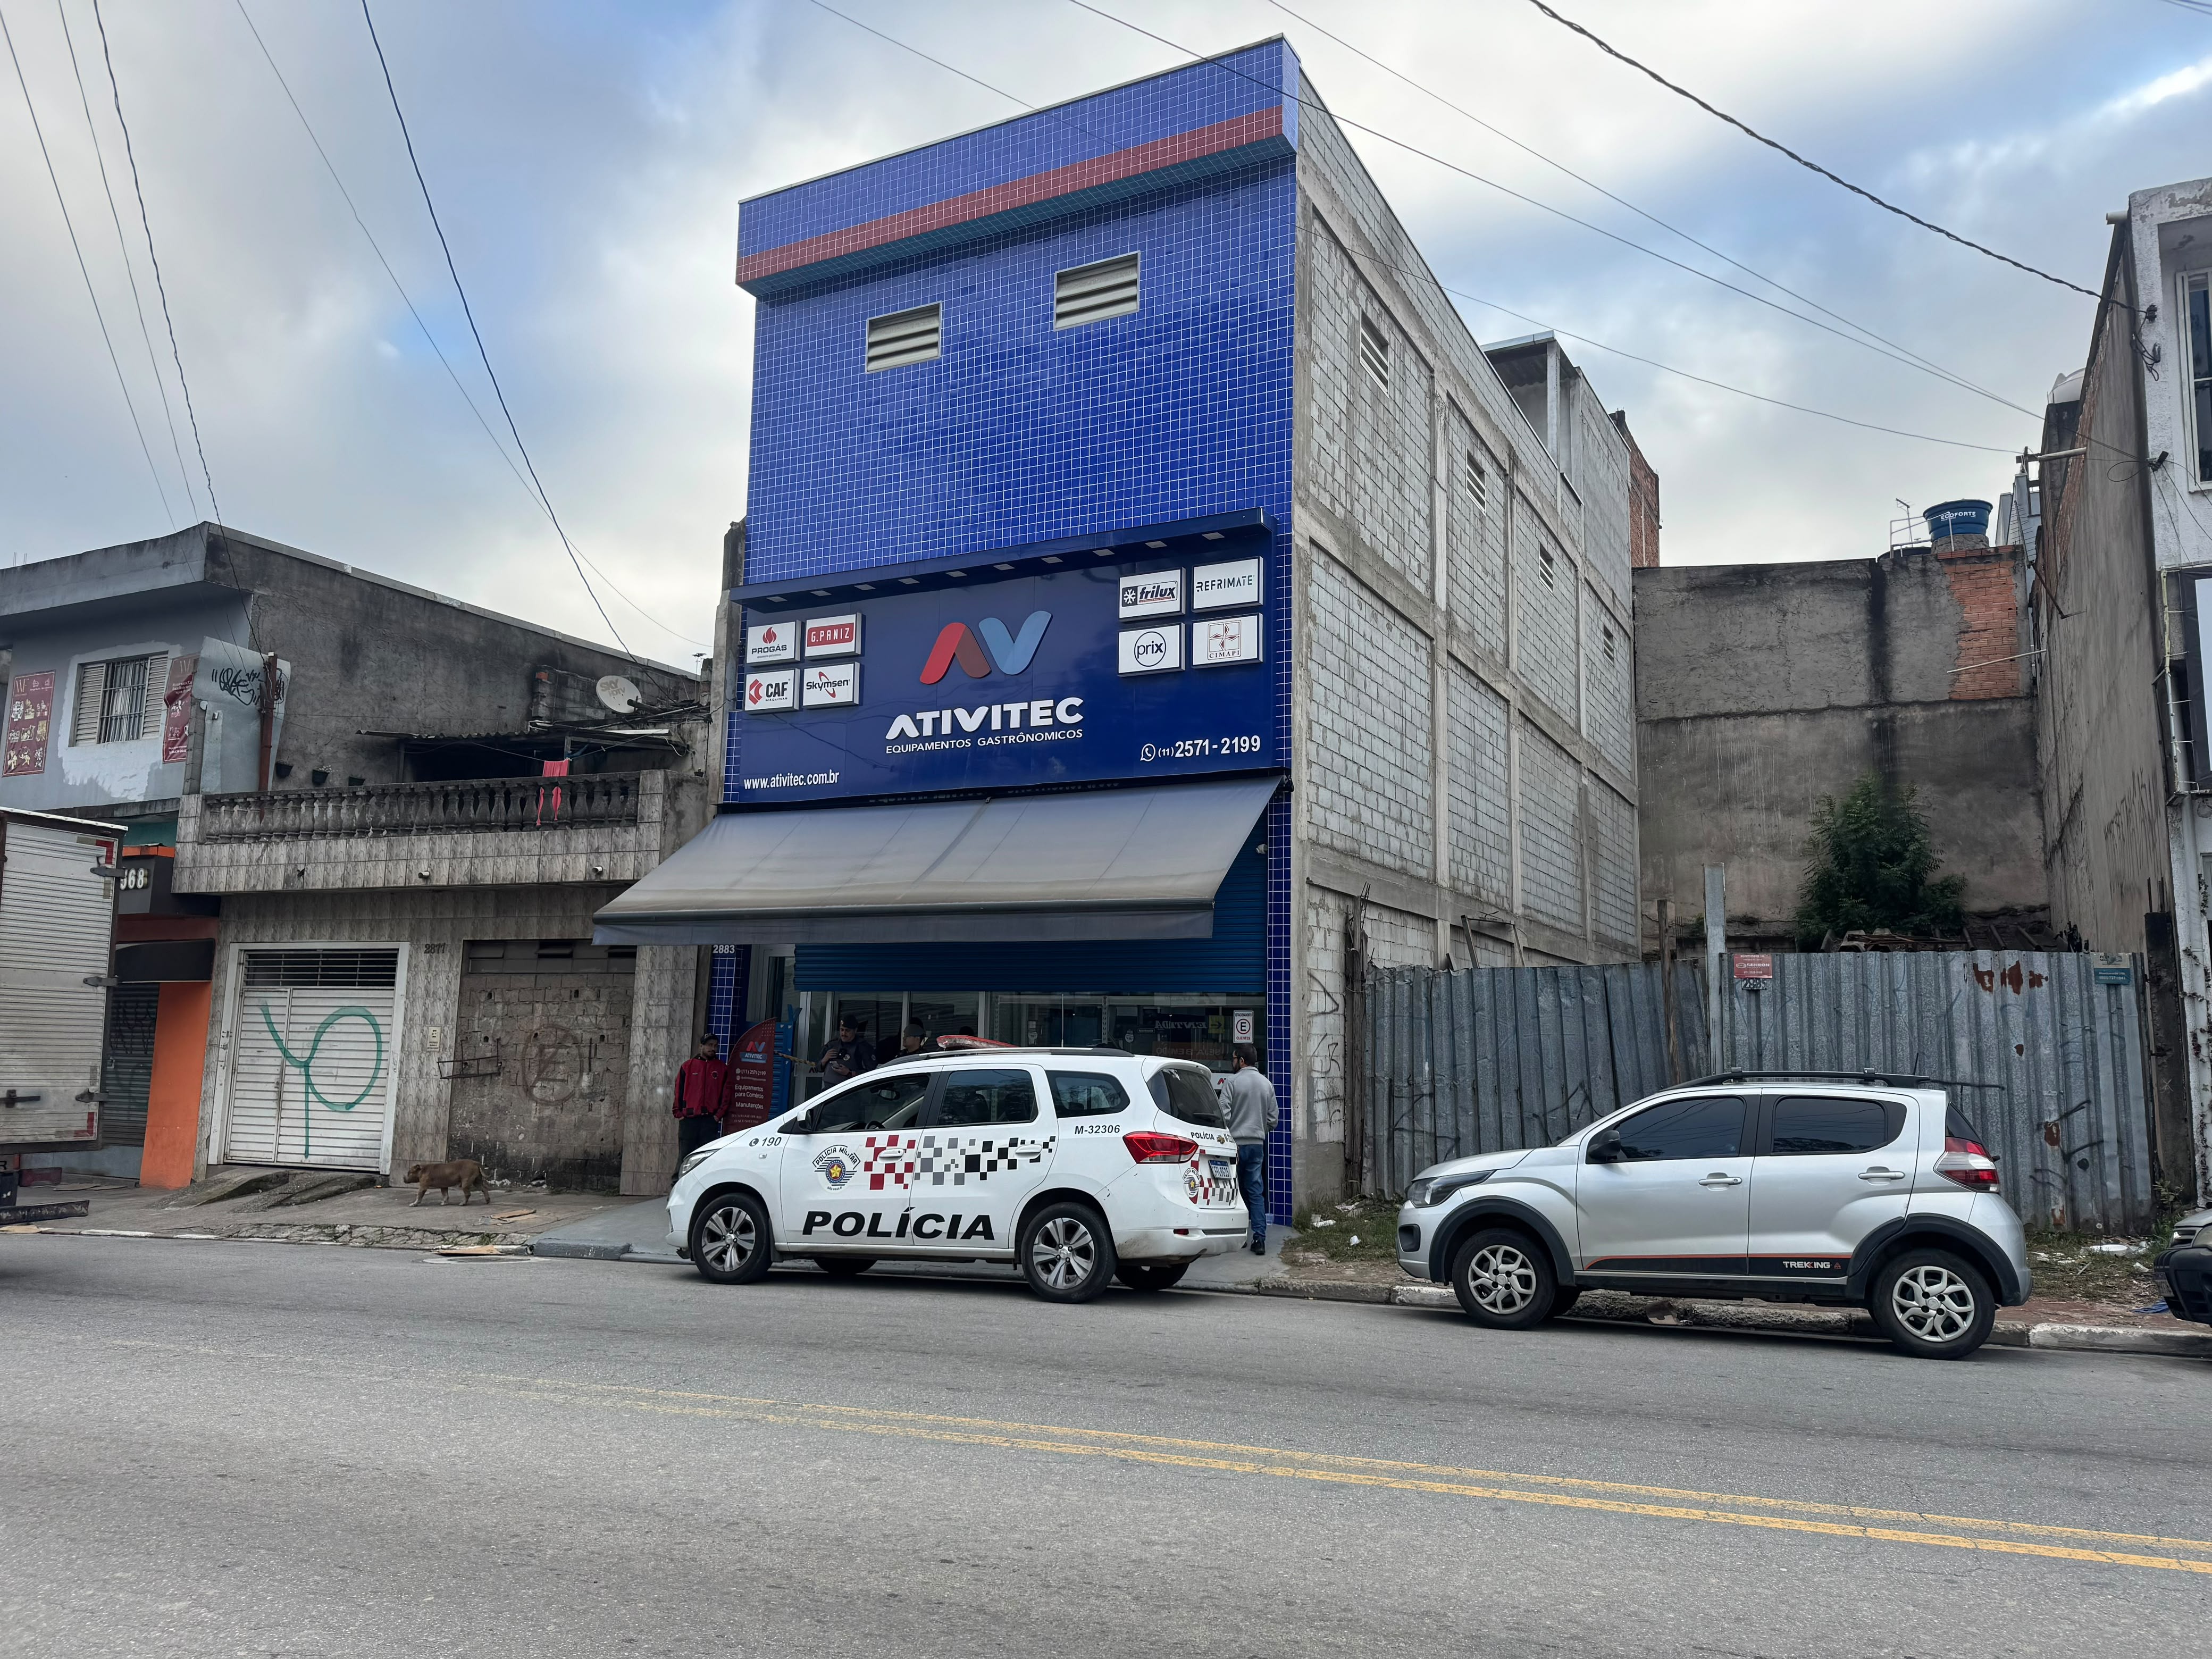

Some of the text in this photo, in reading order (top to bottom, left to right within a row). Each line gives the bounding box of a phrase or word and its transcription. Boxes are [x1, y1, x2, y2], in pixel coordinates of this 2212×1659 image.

[1196, 575, 1253, 592] REFRIMATE
[1139, 585, 1176, 599] frilux
[811, 627, 850, 642] G.PANIZ
[751, 644, 787, 655] PROGÁS
[1137, 640, 1164, 659] prix
[1209, 650, 1239, 659] CIMAPI
[766, 681, 788, 698] CAF
[806, 679, 849, 691] Skymsen
[885, 697, 1084, 740] ATIVITEC
[886, 729, 1083, 754] EQUIPAMENTOS GASTRÔNOMICOS
[744, 769, 840, 790] www.ativitec.com.br
[713, 944, 735, 953] 2883
[1240, 1021, 1246, 1032] E
[1075, 1125, 1120, 1134] M-32306
[1191, 1132, 1215, 1141] POLÍCIA
[762, 1137, 782, 1146] 190
[815, 1146, 858, 1166] POLÍCIA MILITAR
[802, 1206, 995, 1241] POLÍCIA
